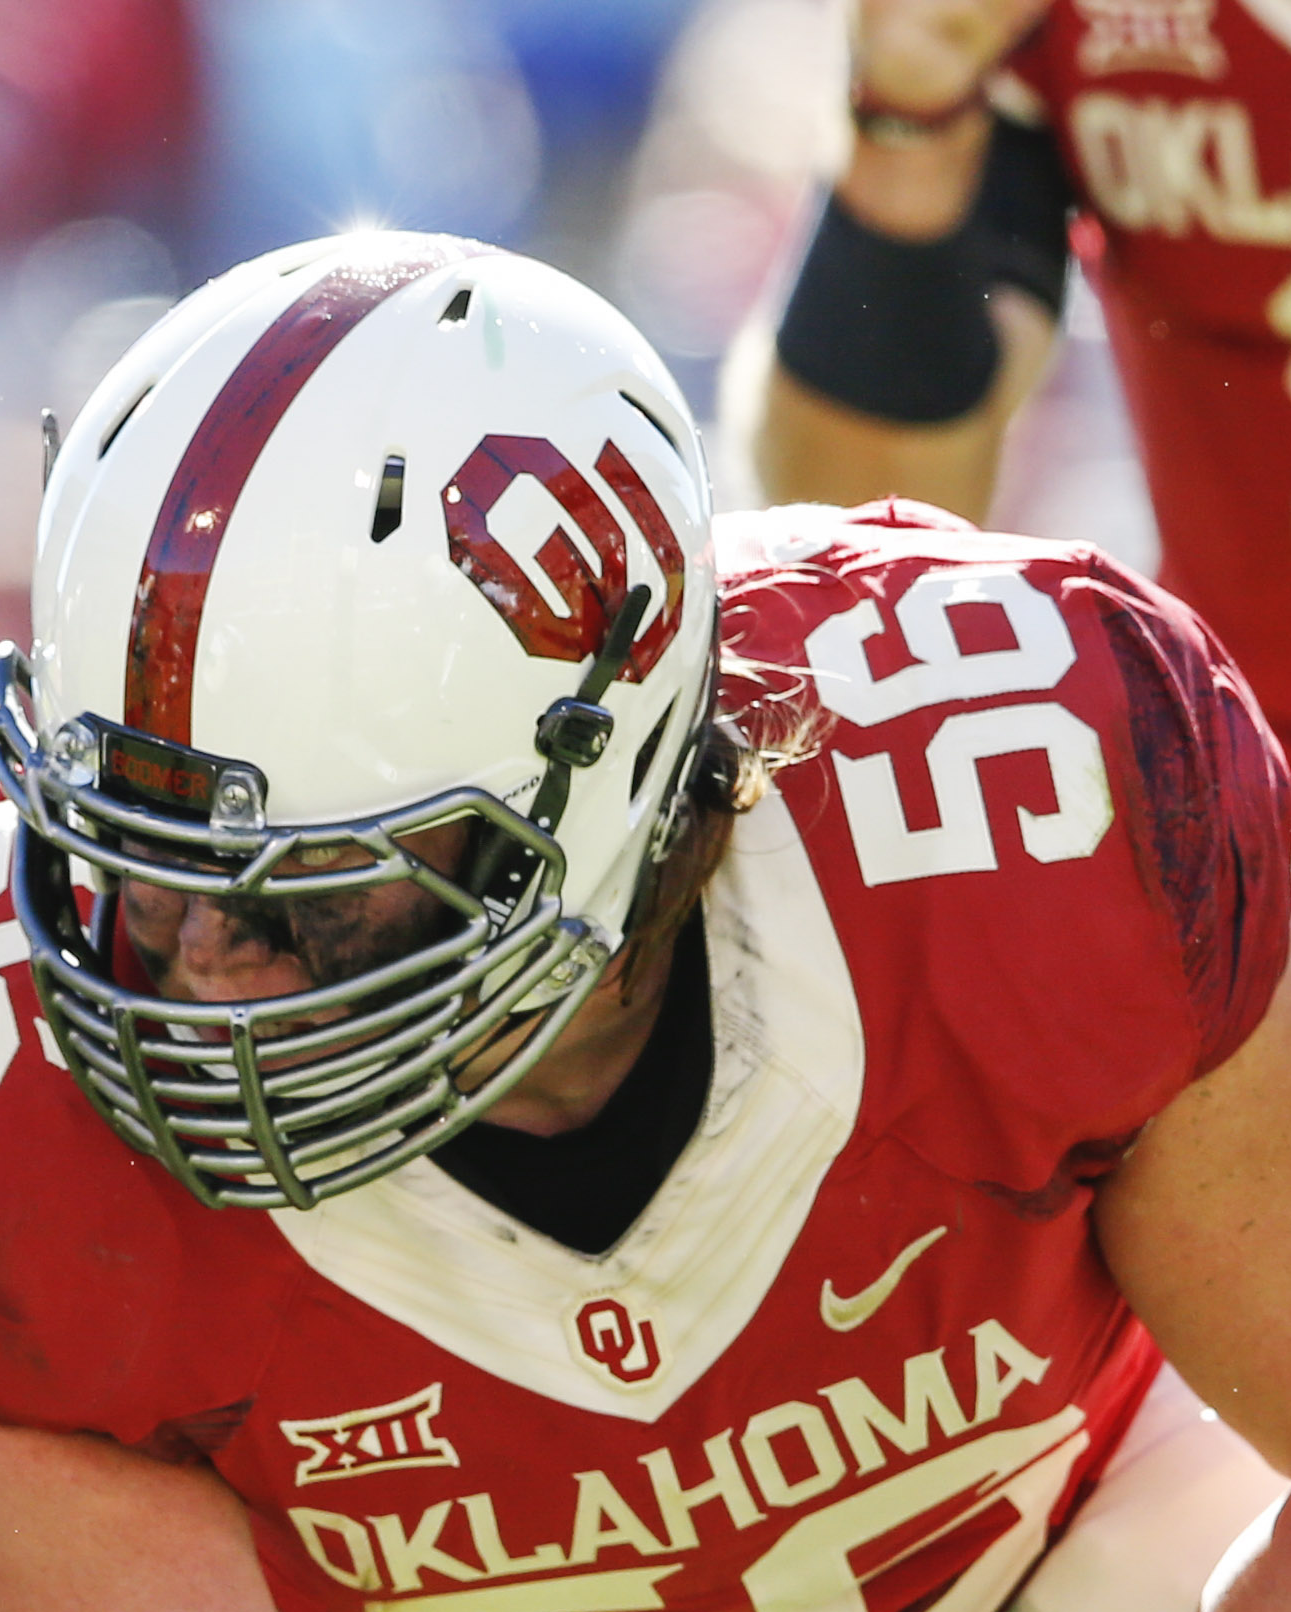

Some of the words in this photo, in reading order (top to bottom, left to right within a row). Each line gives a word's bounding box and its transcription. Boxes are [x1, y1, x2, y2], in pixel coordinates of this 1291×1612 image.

[111, 749, 208, 799] BOOMER
[804, 568, 1115, 888] 56
[575, 1298, 661, 1383] OU
[287, 1317, 1052, 1593] OKLAHOMA
